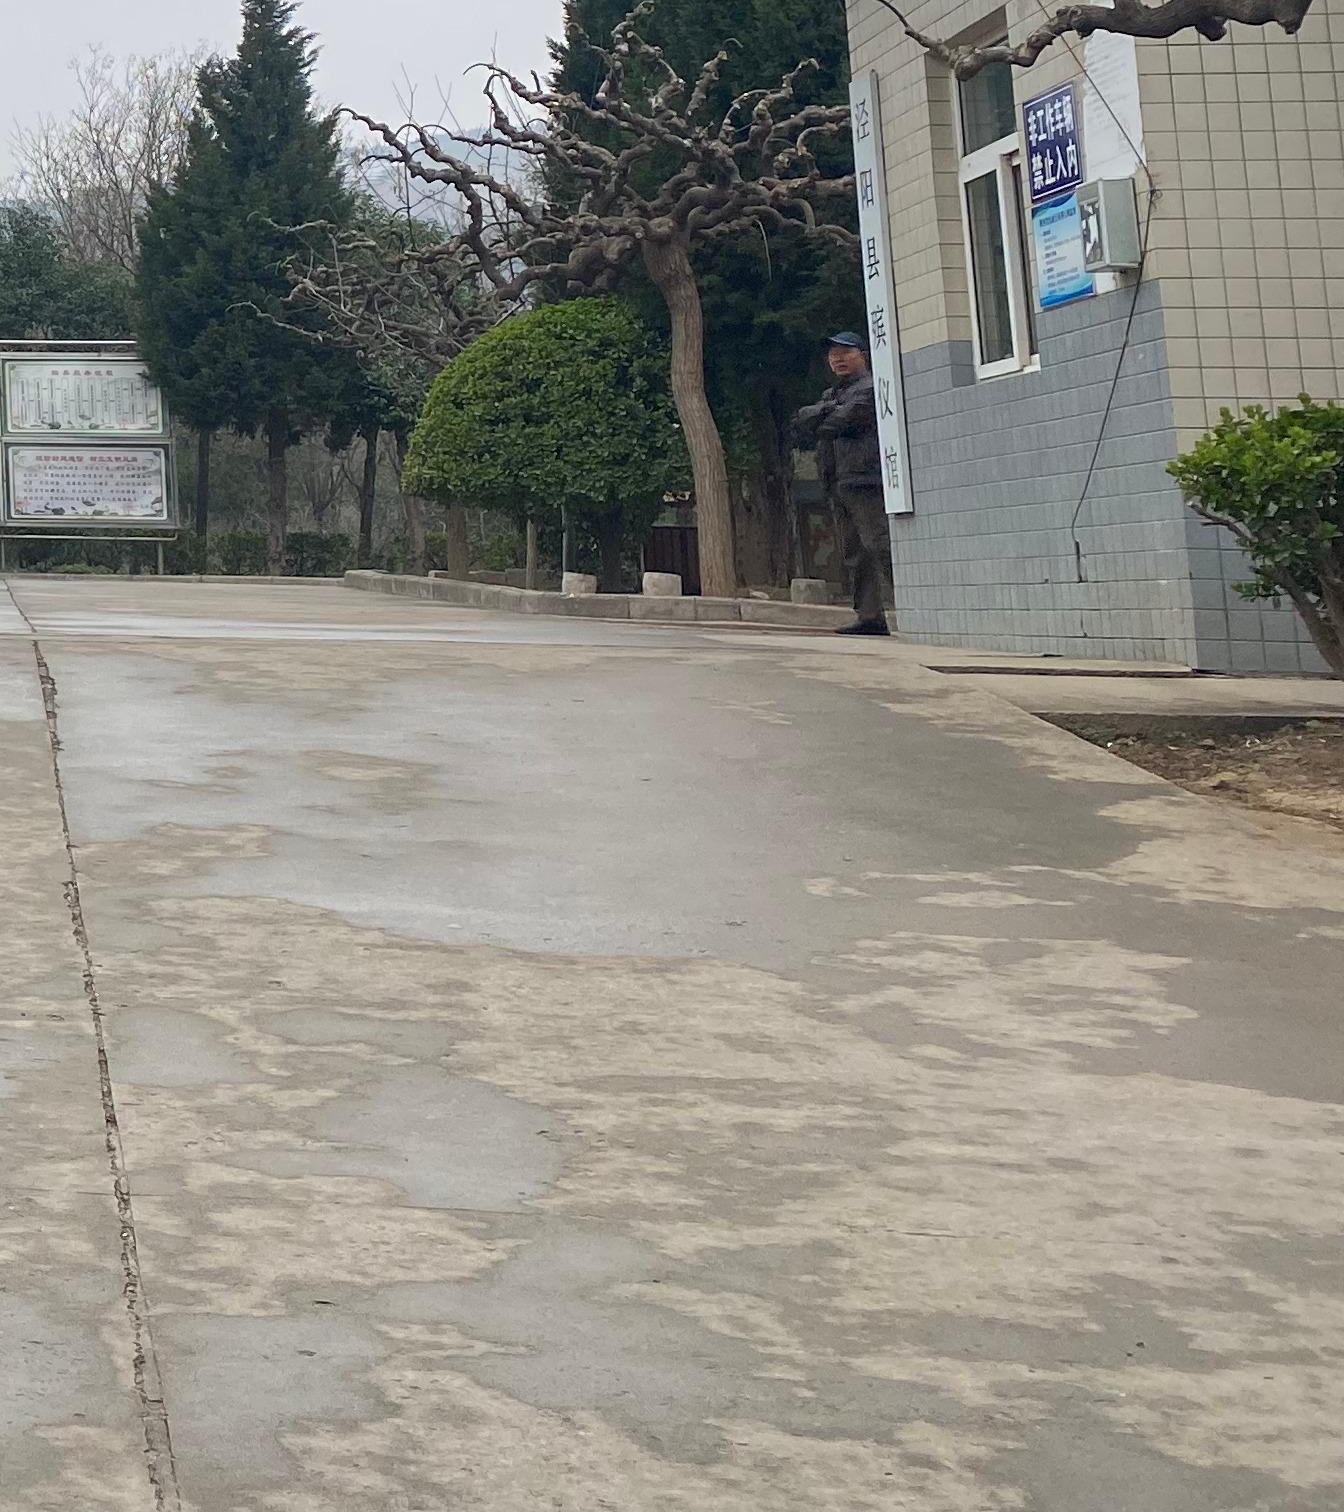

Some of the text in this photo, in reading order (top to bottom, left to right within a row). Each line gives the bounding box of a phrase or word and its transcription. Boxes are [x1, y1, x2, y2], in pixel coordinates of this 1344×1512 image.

[1031, 138, 1079, 191] 禁止入内
[855, 97, 900, 489] 泾阳县殡仪馆
